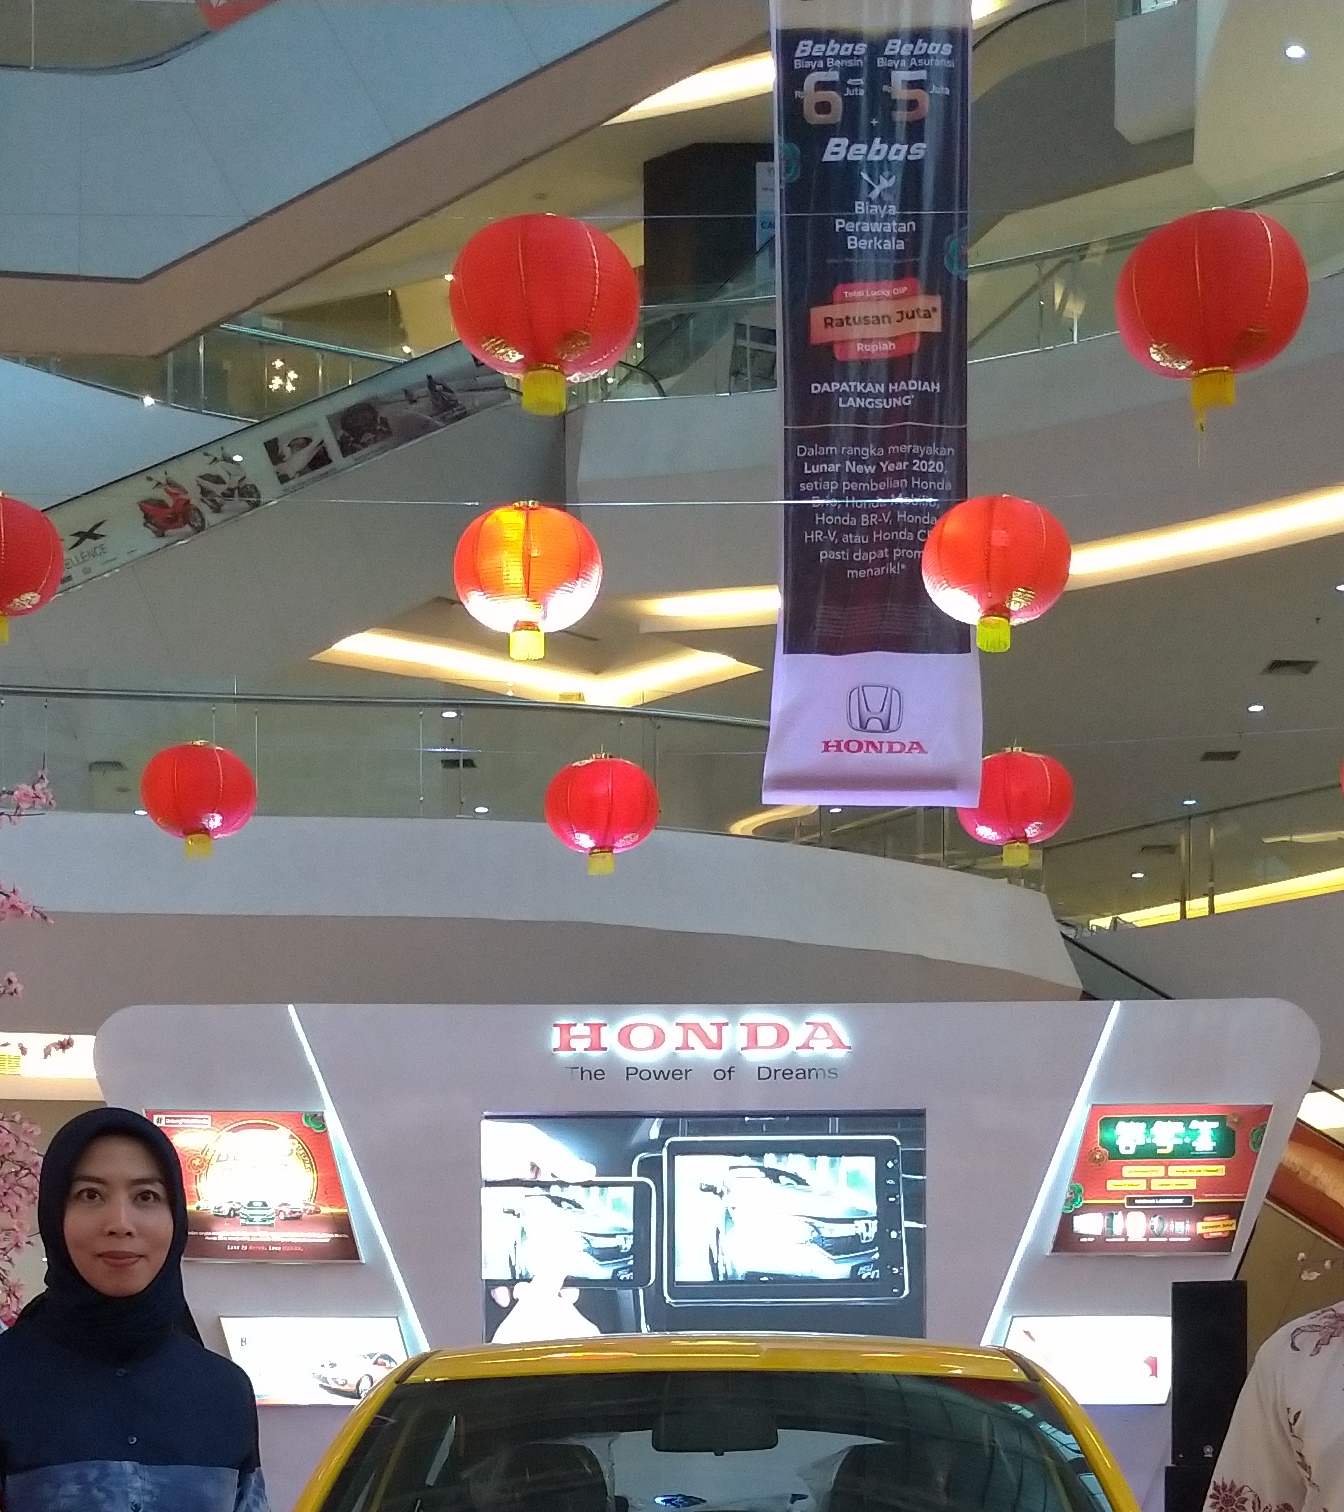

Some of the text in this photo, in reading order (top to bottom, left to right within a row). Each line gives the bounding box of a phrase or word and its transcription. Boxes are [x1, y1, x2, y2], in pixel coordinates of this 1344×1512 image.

[795, 39, 953, 58] Bebas Bebas
[794, 58, 906, 70] Biaya Biaya
[804, 71, 843, 125] 6
[844, 87, 864, 96] Juta
[891, 70, 929, 122] 5
[929, 85, 950, 95] Juta
[821, 137, 927, 163] Bebas
[855, 201, 897, 217] Biaya
[835, 219, 916, 233] Perawatan
[847, 236, 905, 250] Berkala
[823, 314, 892, 330] Ratusan
[811, 380, 941, 394] DAPATKAN HADIAH
[797, 443, 955, 460] Dalam rangka merayakan
[804, 460, 947, 474] Lunar New Year 2020,
[800, 476, 952, 493] setiap pembelian Honda
[815, 511, 938, 527] Honda BR-V, Honda
[804, 530, 838, 544] HR-V,
[842, 533, 869, 544] atau
[873, 528, 914, 543] Honda
[819, 548, 922, 563] pasti dapat prom
[820, 740, 928, 755] HONDA
[553, 1021, 853, 1053] HONDA
[565, 1066, 839, 1081] The Power of Dreams
